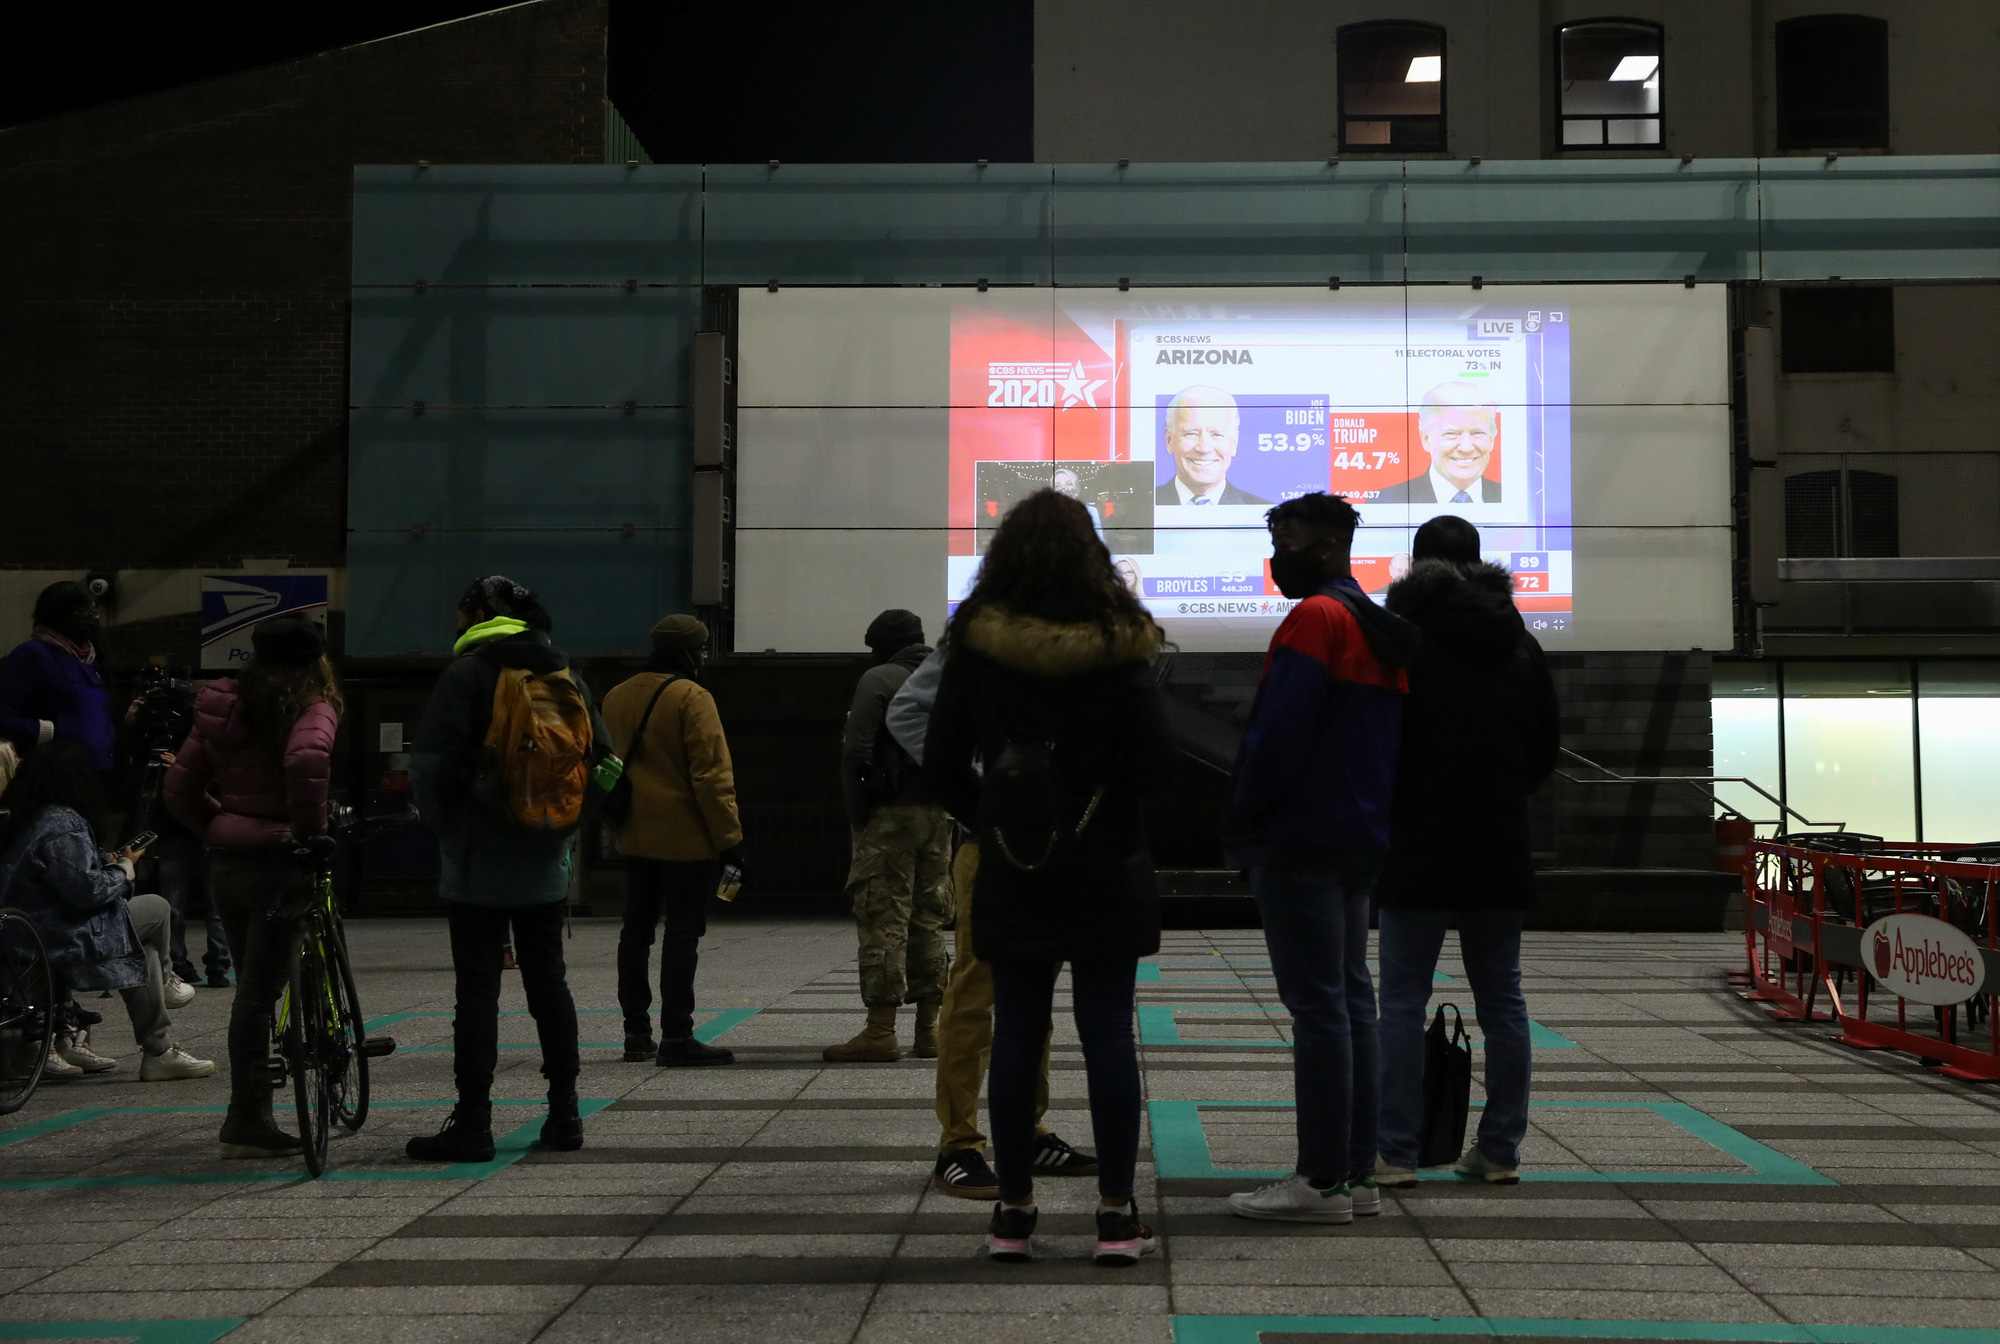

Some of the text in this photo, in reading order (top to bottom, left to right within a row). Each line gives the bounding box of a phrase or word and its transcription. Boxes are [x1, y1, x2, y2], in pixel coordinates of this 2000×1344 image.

[1483, 322, 1514, 333] LIVE
[1163, 335, 1211, 343] CBS NEWS
[1155, 349, 1254, 365] ARIZONA
[1394, 349, 1501, 358] 11 ELECTORAL VOTES
[996, 366, 1045, 375] CBS NEWS
[1490, 361, 1502, 370] IN
[988, 379, 1055, 407] 2020
[1285, 410, 1324, 425] BIDEN
[1333, 418, 1365, 428] DONALD
[1333, 428, 1378, 443] TRUMP
[1258, 432, 1325, 452] 53.9%
[1333, 451, 1400, 470] 44.7%
[1519, 556, 1539, 568] 89
[1156, 579, 1208, 593] BROYLES
[1519, 576, 1539, 588] 72
[1189, 602, 1215, 614] CBS
[1218, 602, 1257, 614] NEWS
[1893, 926, 1975, 986] Applebee's
